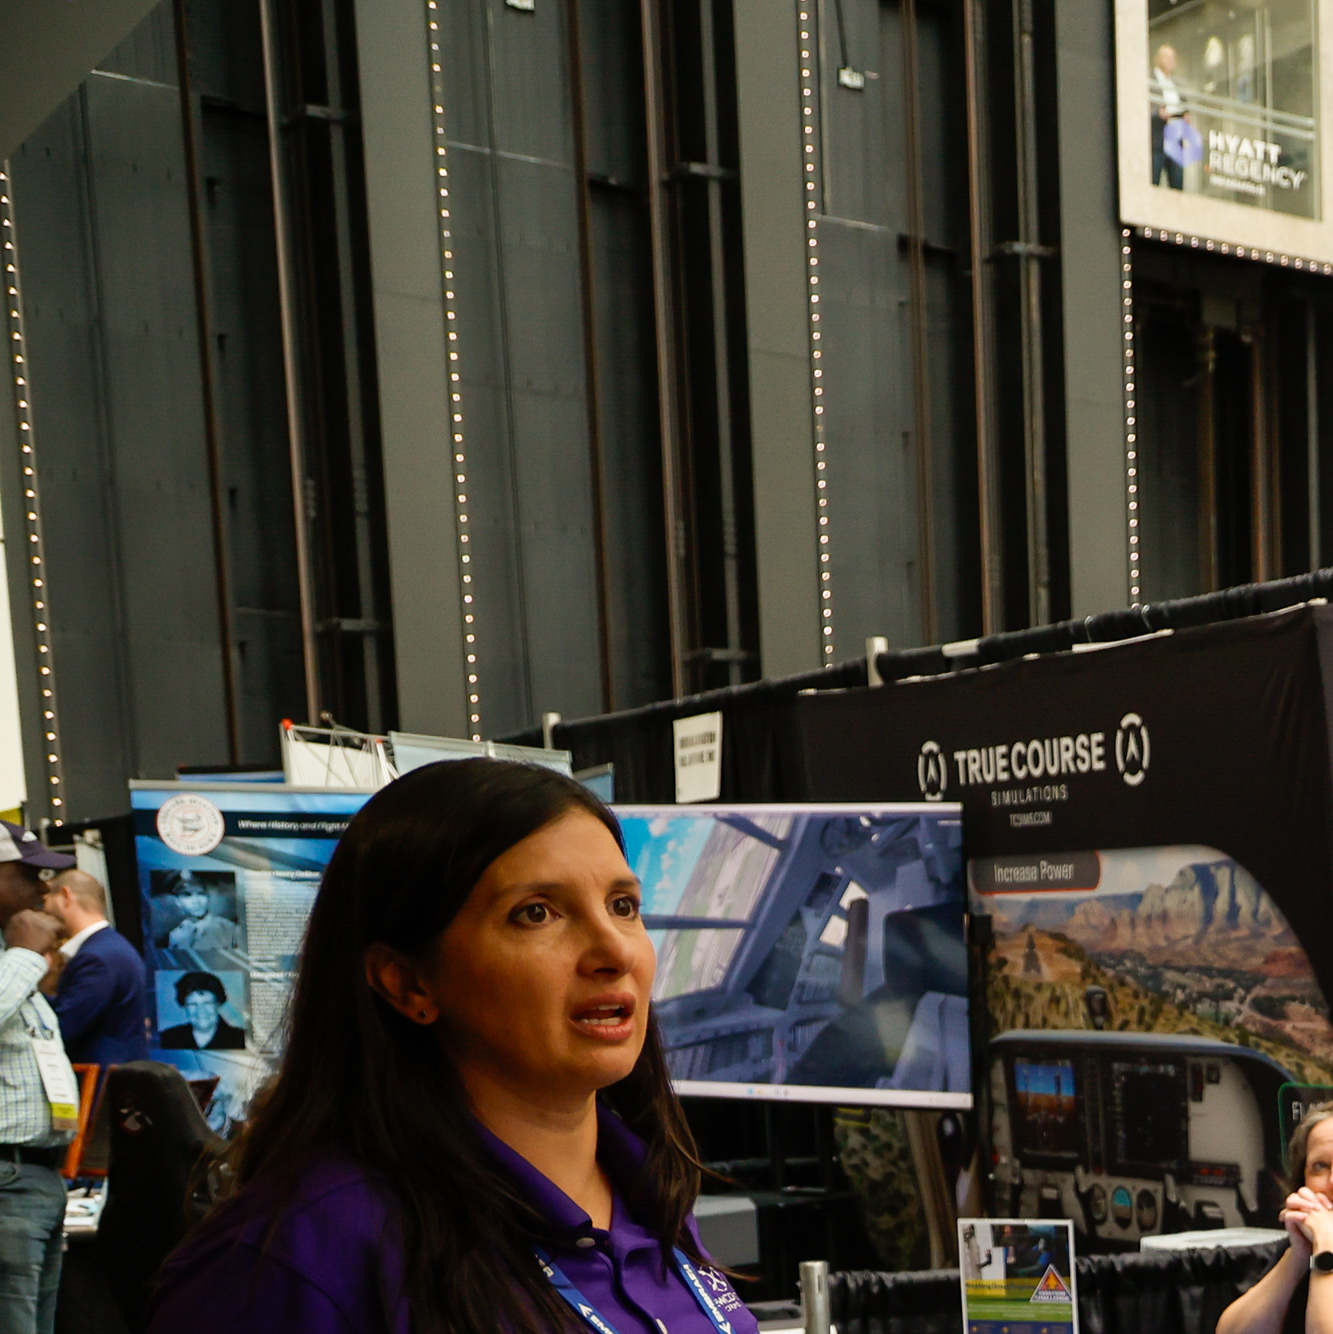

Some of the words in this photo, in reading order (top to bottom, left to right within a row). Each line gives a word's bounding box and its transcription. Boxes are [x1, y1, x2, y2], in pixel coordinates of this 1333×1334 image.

[1209, 129, 1282, 164] HYATT
[1209, 151, 1305, 190] REGENCY
[991, 784, 1068, 807] SIMULATIONS
[994, 862, 1037, 882] Increase
[1040, 860, 1073, 880] Power
